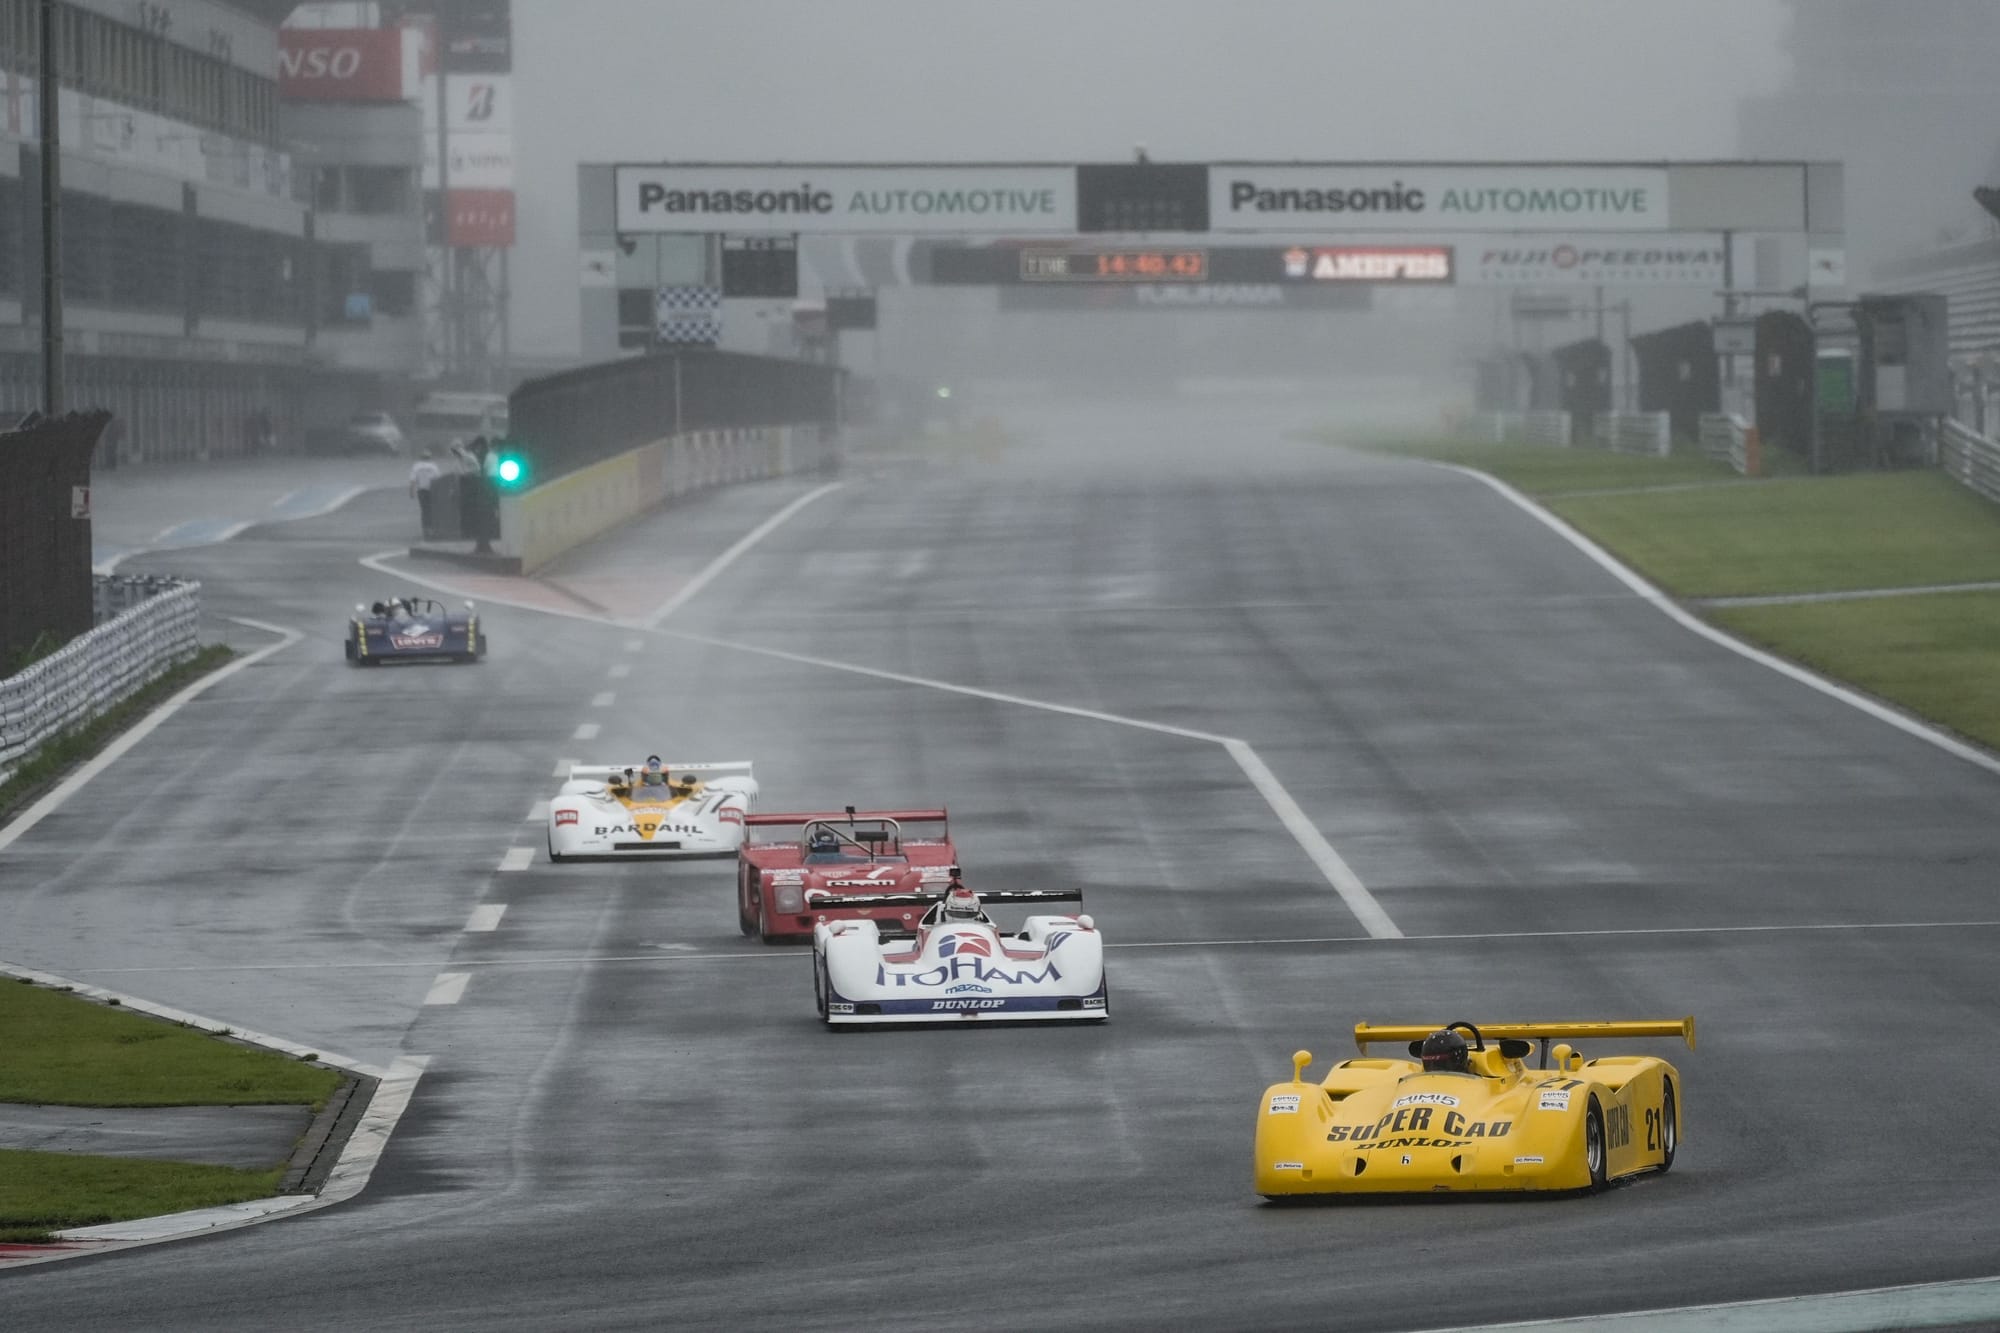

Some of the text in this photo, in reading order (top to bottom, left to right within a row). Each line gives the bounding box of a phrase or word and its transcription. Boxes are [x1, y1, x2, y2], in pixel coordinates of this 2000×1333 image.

[279, 48, 361, 79] NSO
[638, 182, 1056, 214] Panasonic AUTOMOTIVE
[1231, 180, 1648, 213] Panasonic AUTOMOTIVE
[594, 822, 704, 837] BARDAHL
[931, 999, 1005, 1011] DUNLOP
[1327, 1107, 1512, 1142] SUPER CAD
[1645, 1107, 1662, 1151] 21
[1354, 1137, 1473, 1150] DUNLOP
